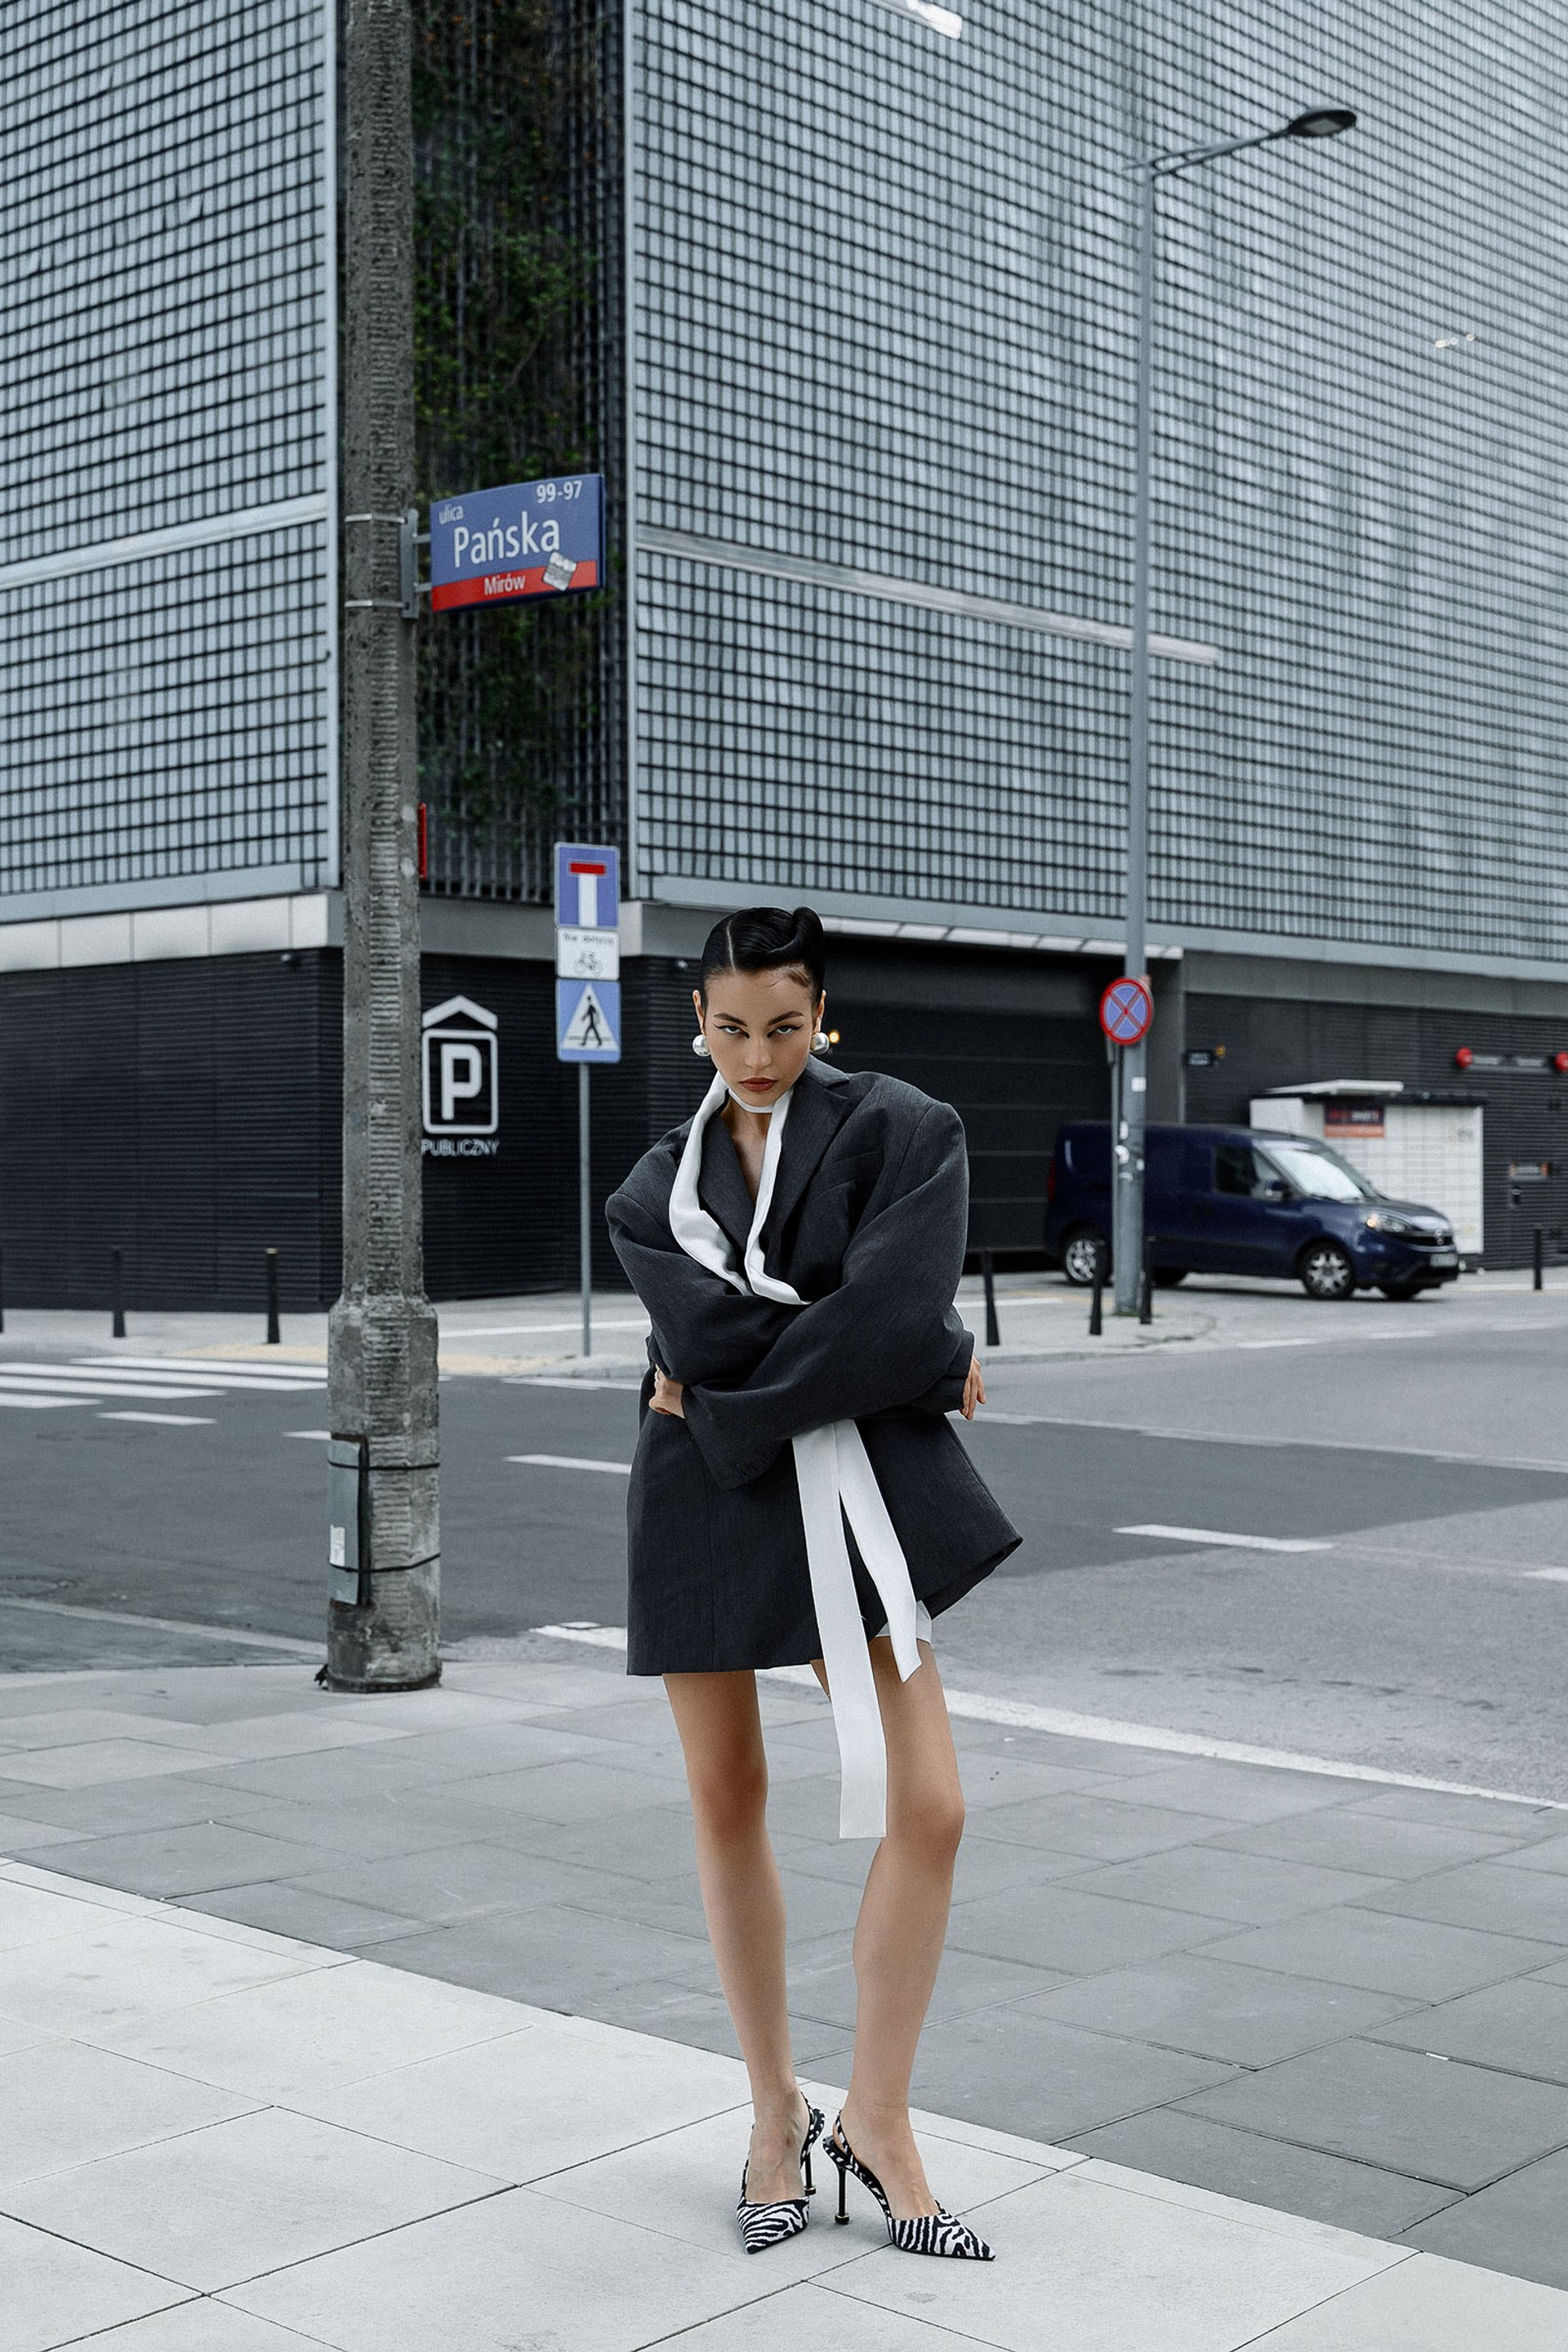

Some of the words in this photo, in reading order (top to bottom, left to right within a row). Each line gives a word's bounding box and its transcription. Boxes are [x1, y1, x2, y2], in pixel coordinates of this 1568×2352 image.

[536, 480, 583, 504] 99-97
[438, 504, 465, 525] ulica
[453, 510, 560, 568] Pańska
[483, 572, 526, 596] Mirów
[441, 1042, 483, 1120] P
[421, 1138, 500, 1157] PUBLICZNY
